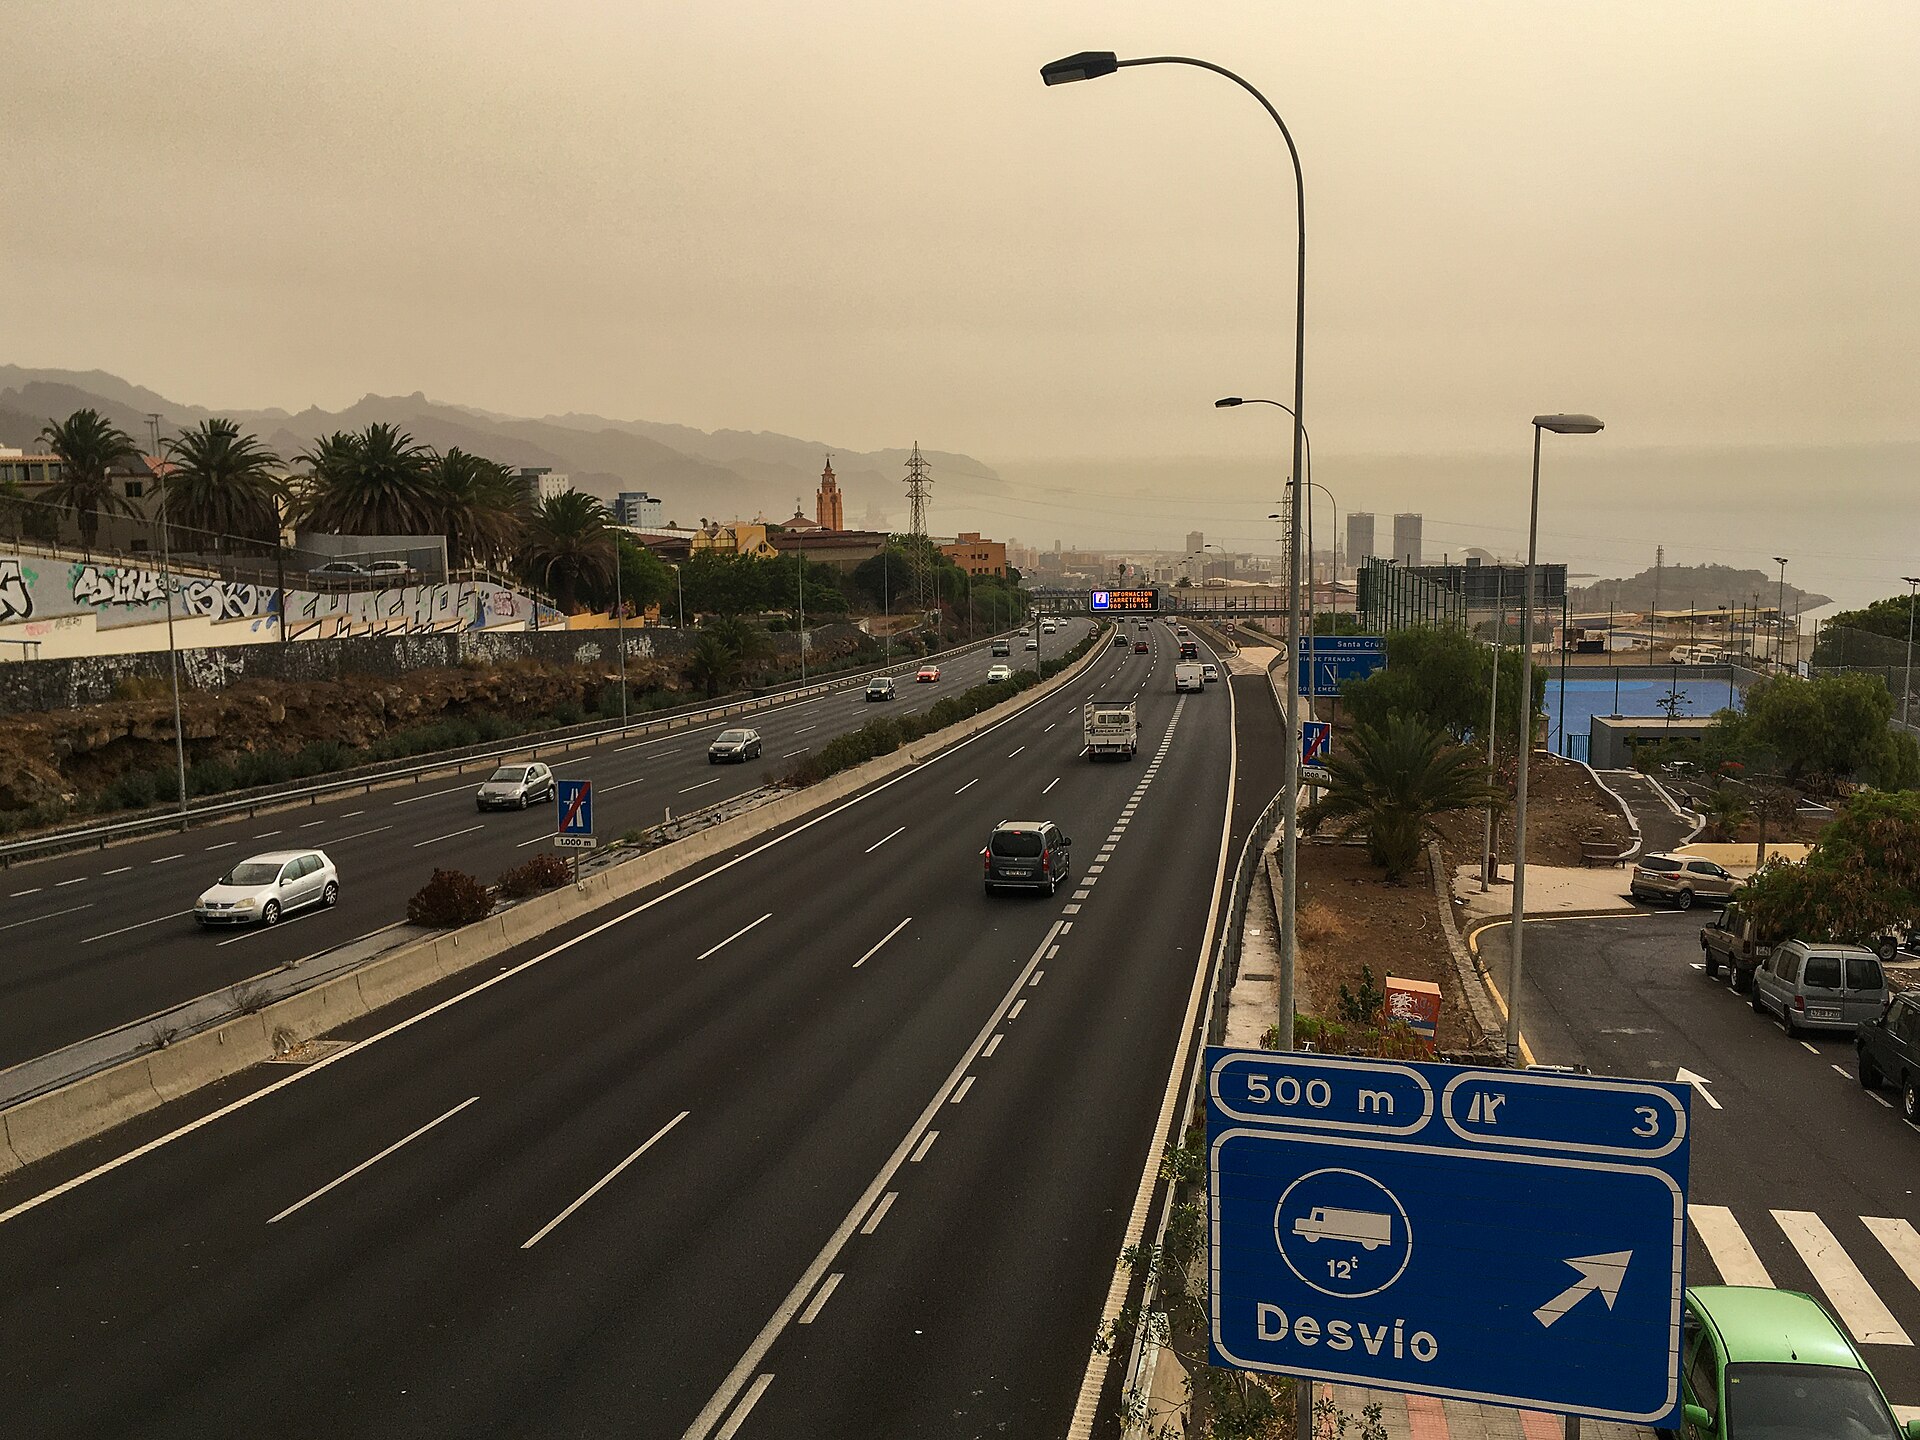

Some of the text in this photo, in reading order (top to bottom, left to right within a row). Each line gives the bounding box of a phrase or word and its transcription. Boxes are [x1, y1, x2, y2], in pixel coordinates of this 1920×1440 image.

[1337, 640, 1361, 648] Santa
[1247, 1073, 1394, 1115] 500 m
[1632, 1105, 1659, 1138] 3
[1257, 1301, 1439, 1363] Desvío
